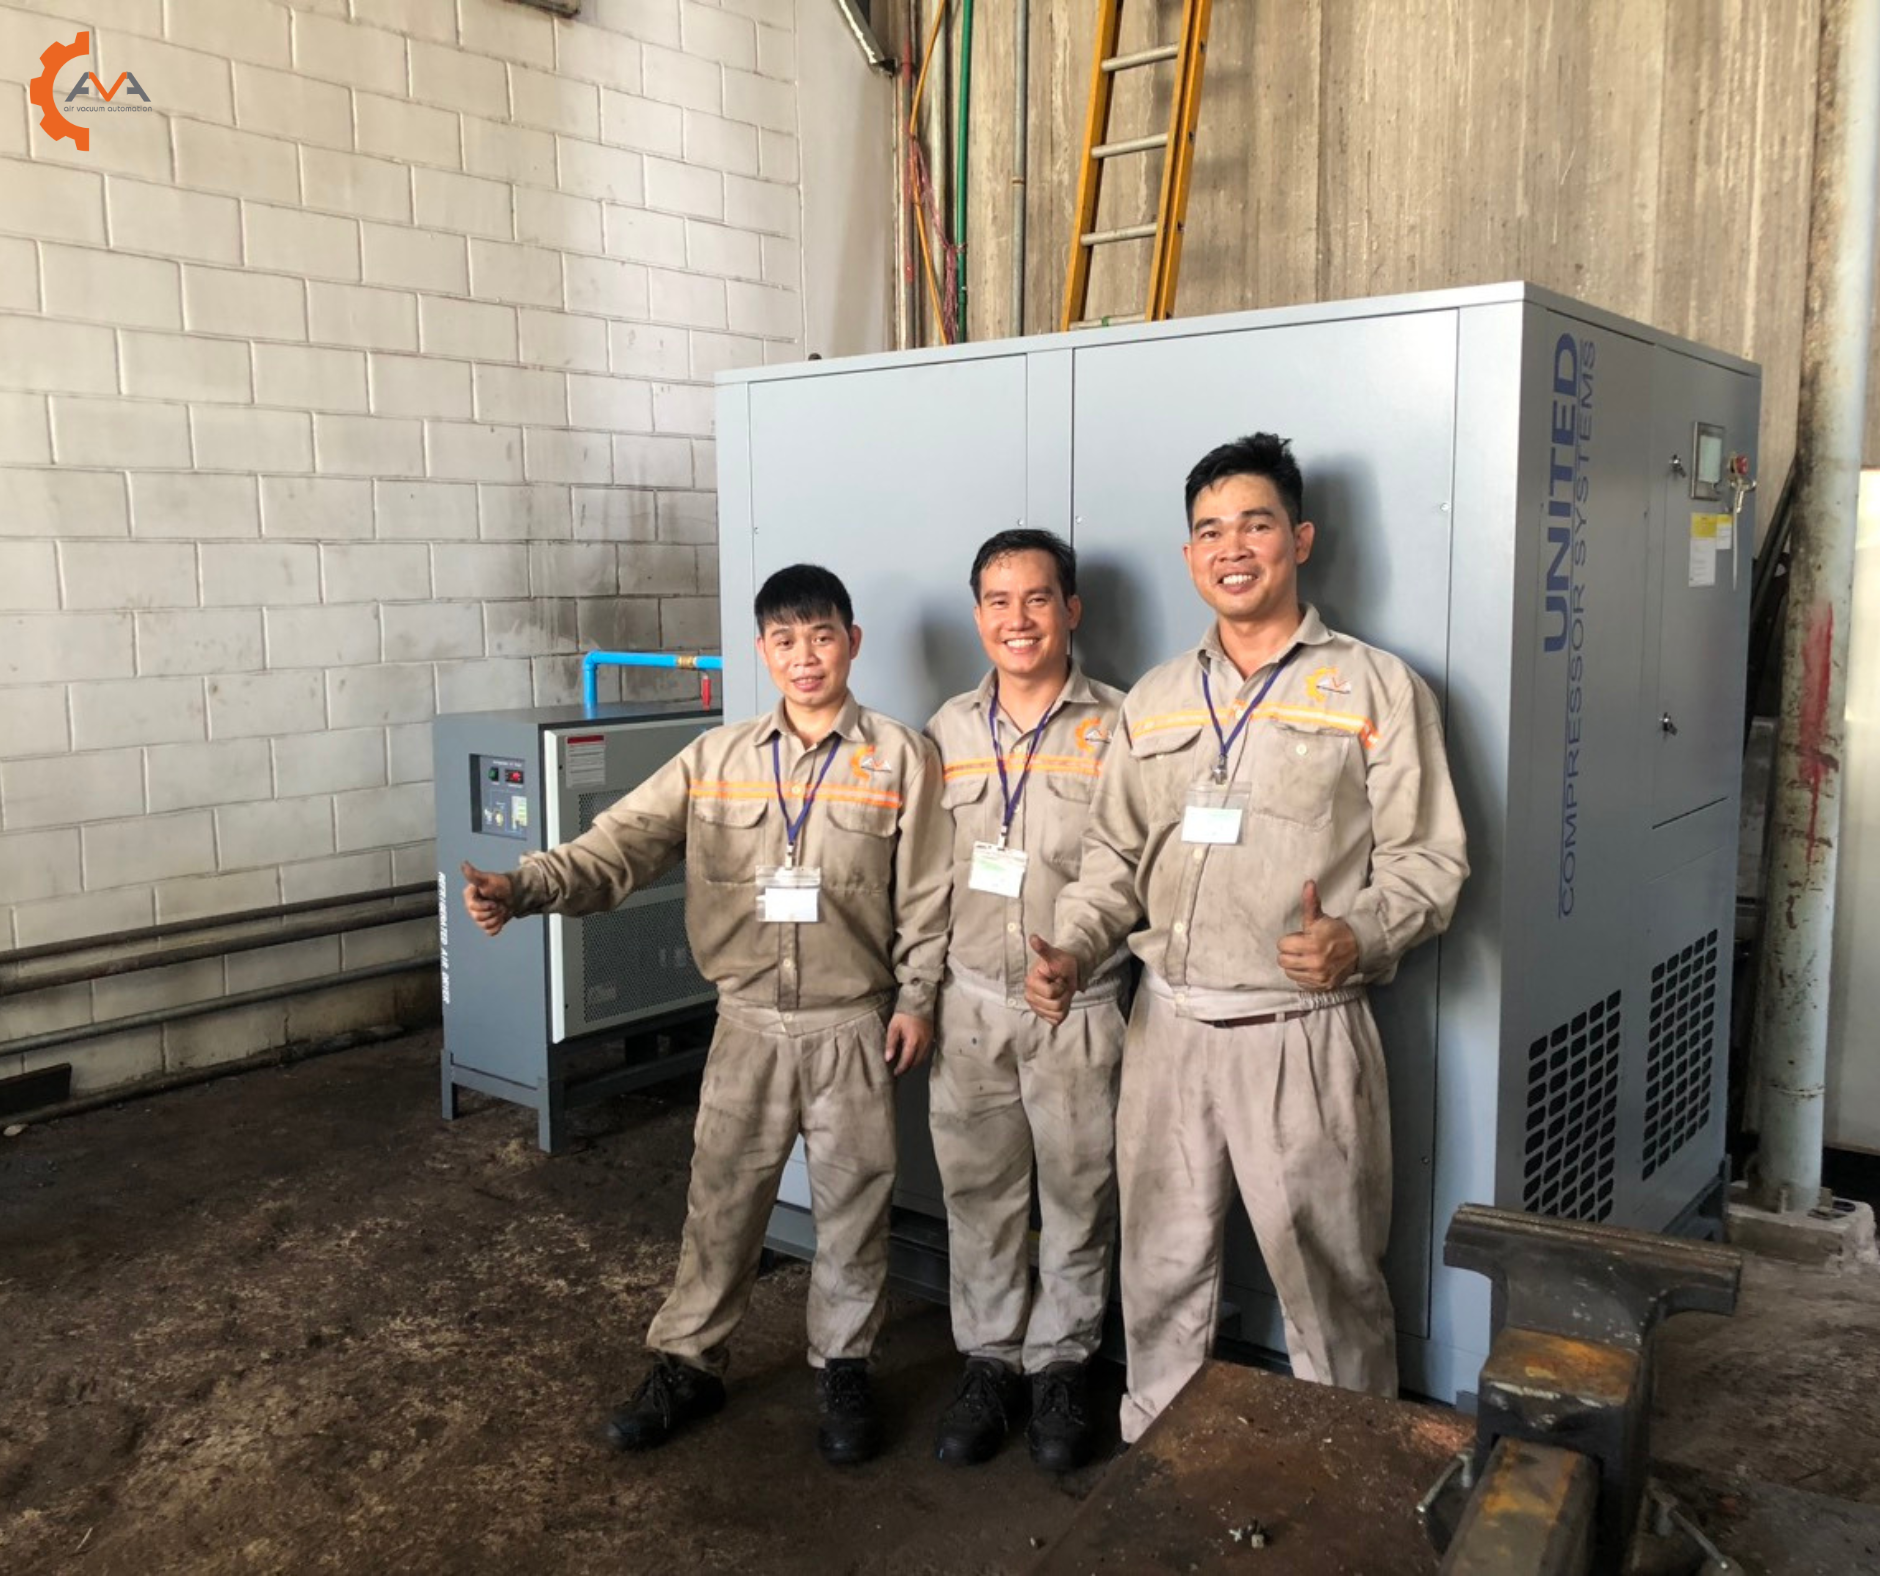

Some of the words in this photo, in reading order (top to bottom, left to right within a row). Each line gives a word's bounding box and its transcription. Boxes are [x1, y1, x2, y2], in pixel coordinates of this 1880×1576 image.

[1544, 332, 1578, 652] UNITED
[1560, 584, 1585, 918] COMPRESSOR
[1573, 340, 1596, 566] SYSTEMS
[437, 871, 448, 945] REFRIGERATED
[440, 947, 450, 969] AIR
[441, 971, 451, 1005] DRYER
